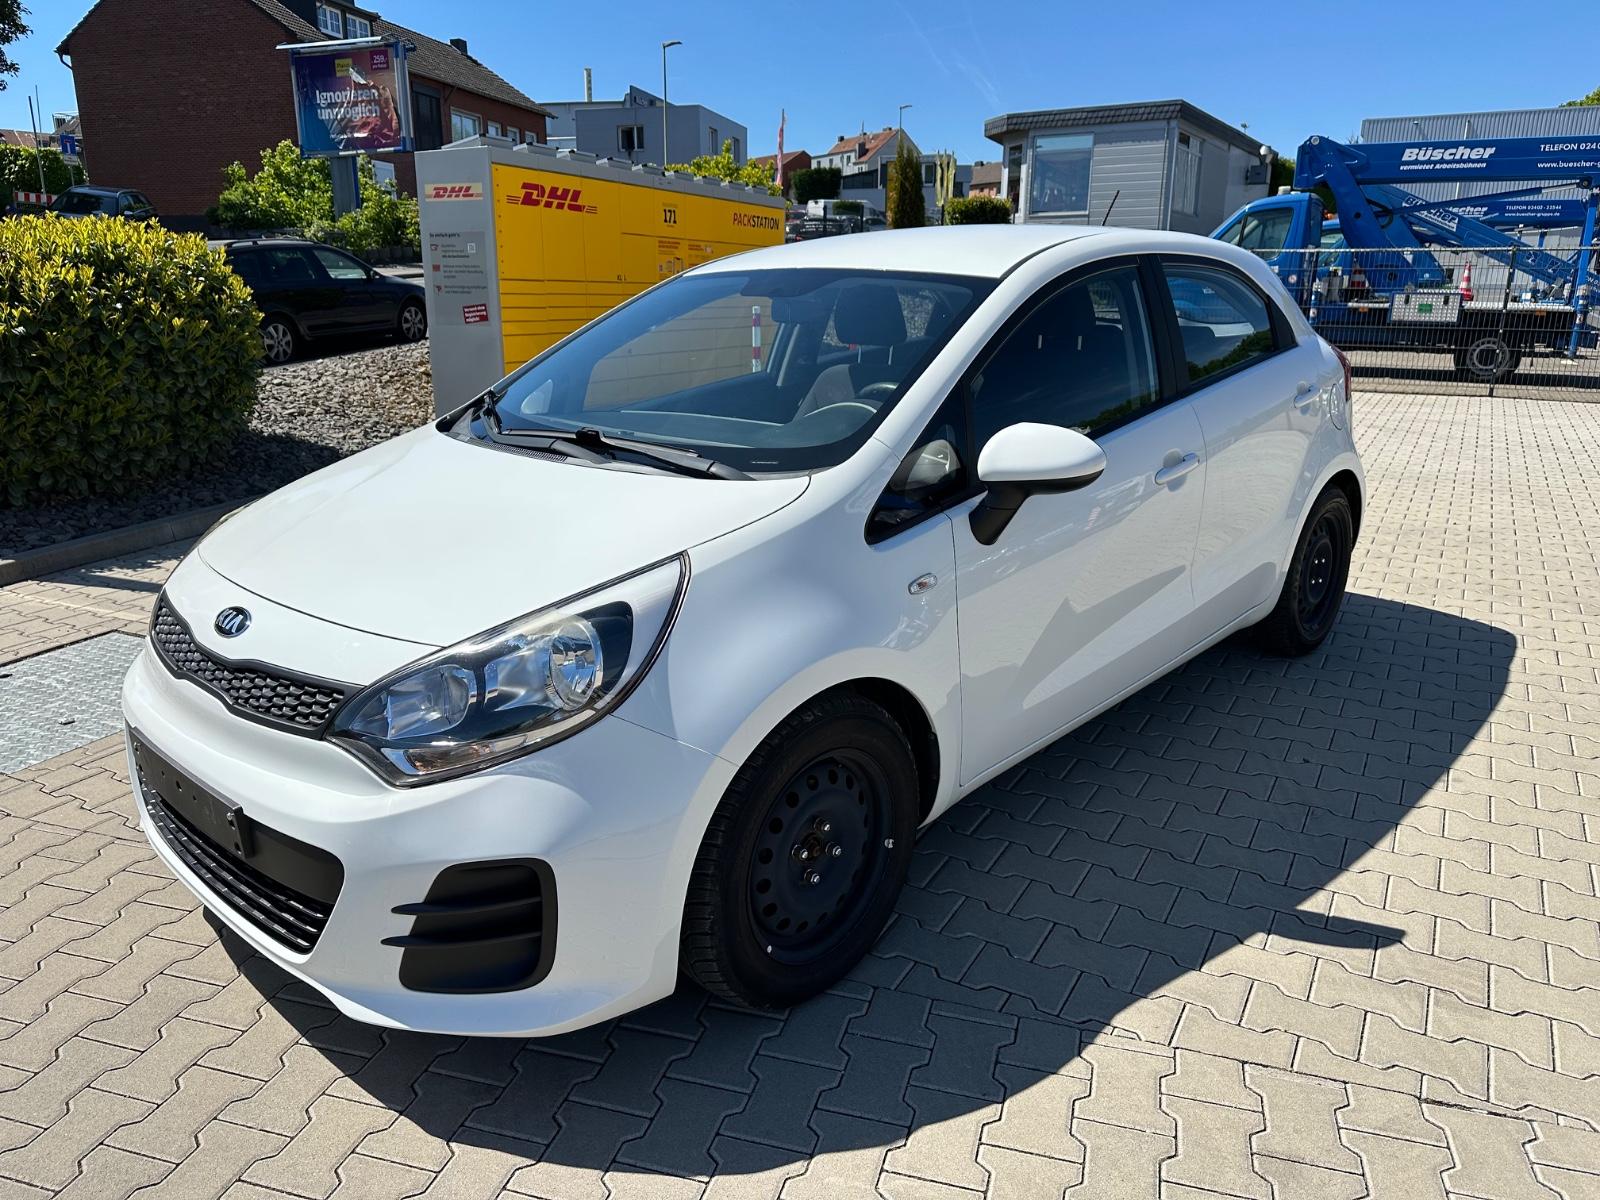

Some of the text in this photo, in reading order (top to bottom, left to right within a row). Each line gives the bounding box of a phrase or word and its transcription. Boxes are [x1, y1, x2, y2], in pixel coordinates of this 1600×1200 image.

[315, 87, 379, 107] Ignorieren
[1401, 146, 1496, 161] Büscher
[1540, 143, 1578, 151] TELEFON
[433, 186, 474, 198] DHL
[520, 182, 586, 212] DHL
[663, 208, 677, 224] 171
[733, 212, 780, 230] PACKSTATION
[216, 608, 244, 633] KIA
